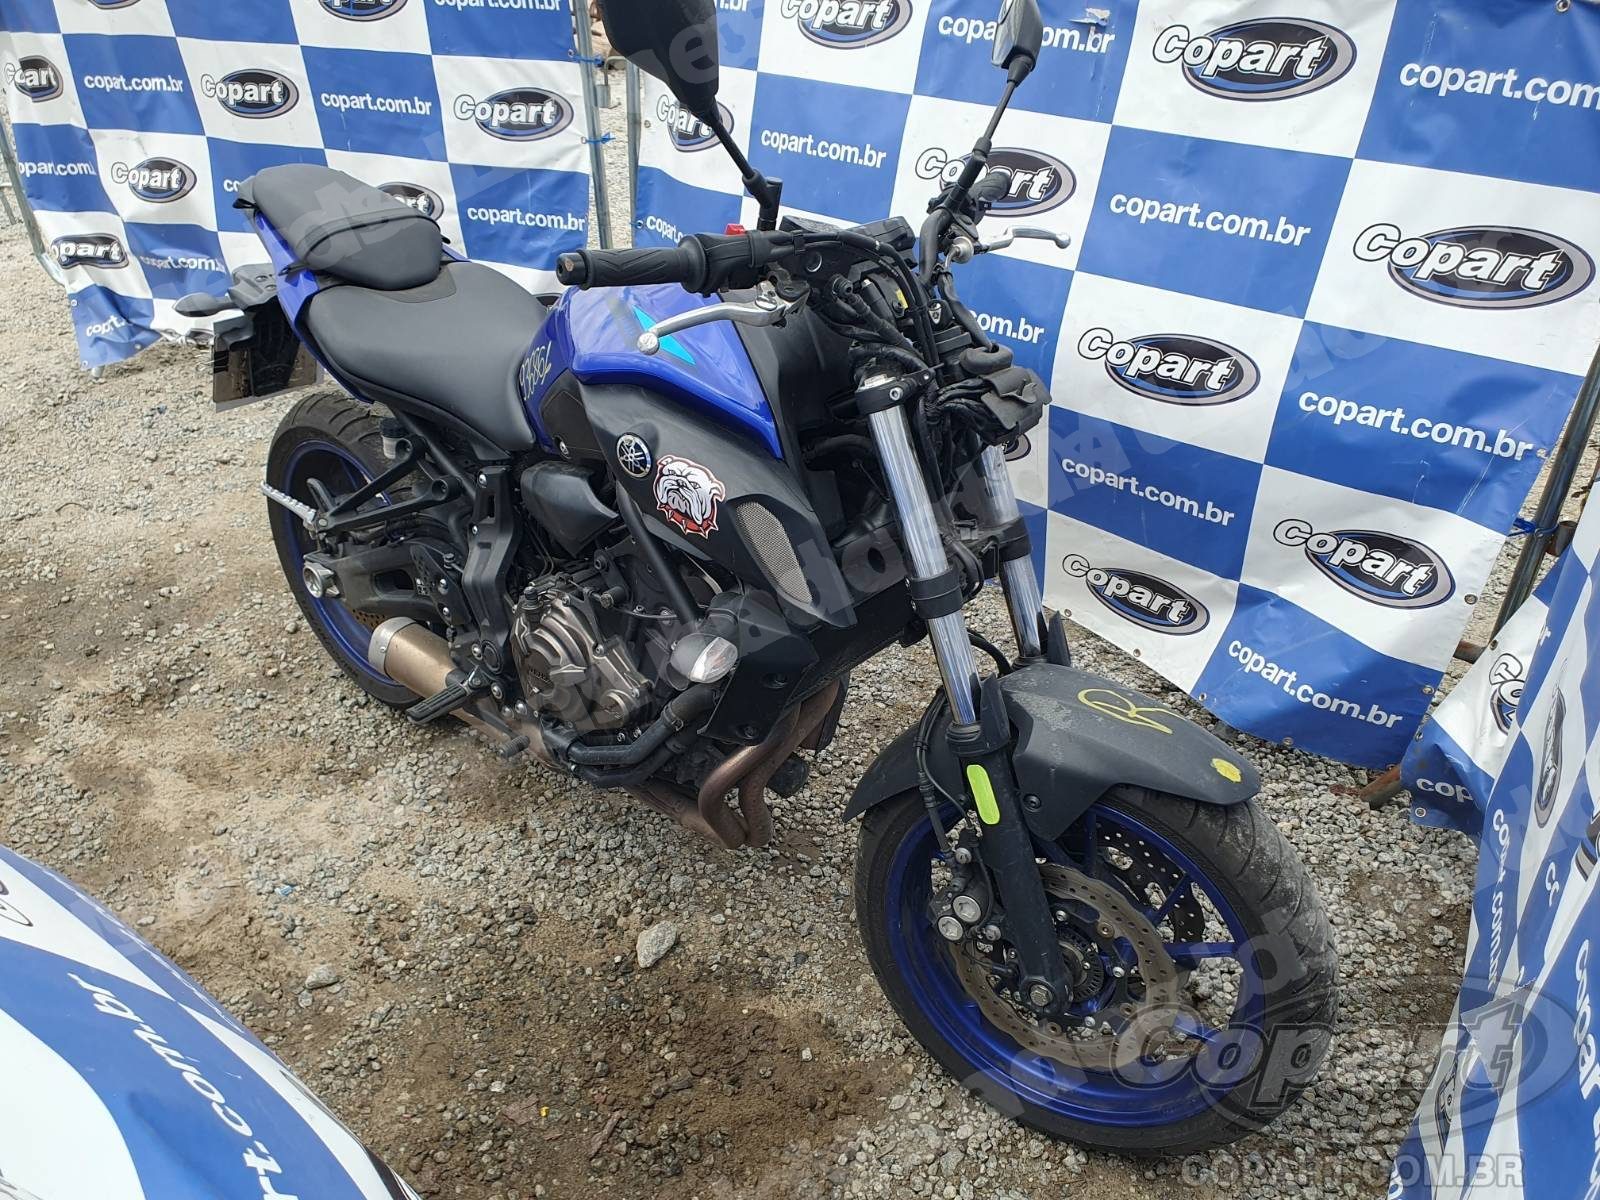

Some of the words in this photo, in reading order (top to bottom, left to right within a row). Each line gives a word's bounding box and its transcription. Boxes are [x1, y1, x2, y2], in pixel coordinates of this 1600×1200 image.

[780, 0, 894, 30] Copart
[1153, 25, 1330, 79] Copart
[201, 74, 284, 104] Copart
[321, 92, 432, 116] copart.com.br
[454, 94, 557, 125] Copart
[761, 128, 887, 168] copart.com.br
[111, 162, 181, 190] Copart
[467, 205, 586, 231] copart.com.br
[1110, 193, 1312, 247] copart.com.br
[1353, 223, 1566, 292] Copart
[1077, 327, 1236, 395] Copart
[1298, 390, 1534, 462] copart.com.br
[1061, 456, 1235, 527] copart.com.br
[1273, 518, 1433, 599] Copart
[1062, 553, 1190, 626] Copart
[1228, 638, 1404, 732] copart.com.br
